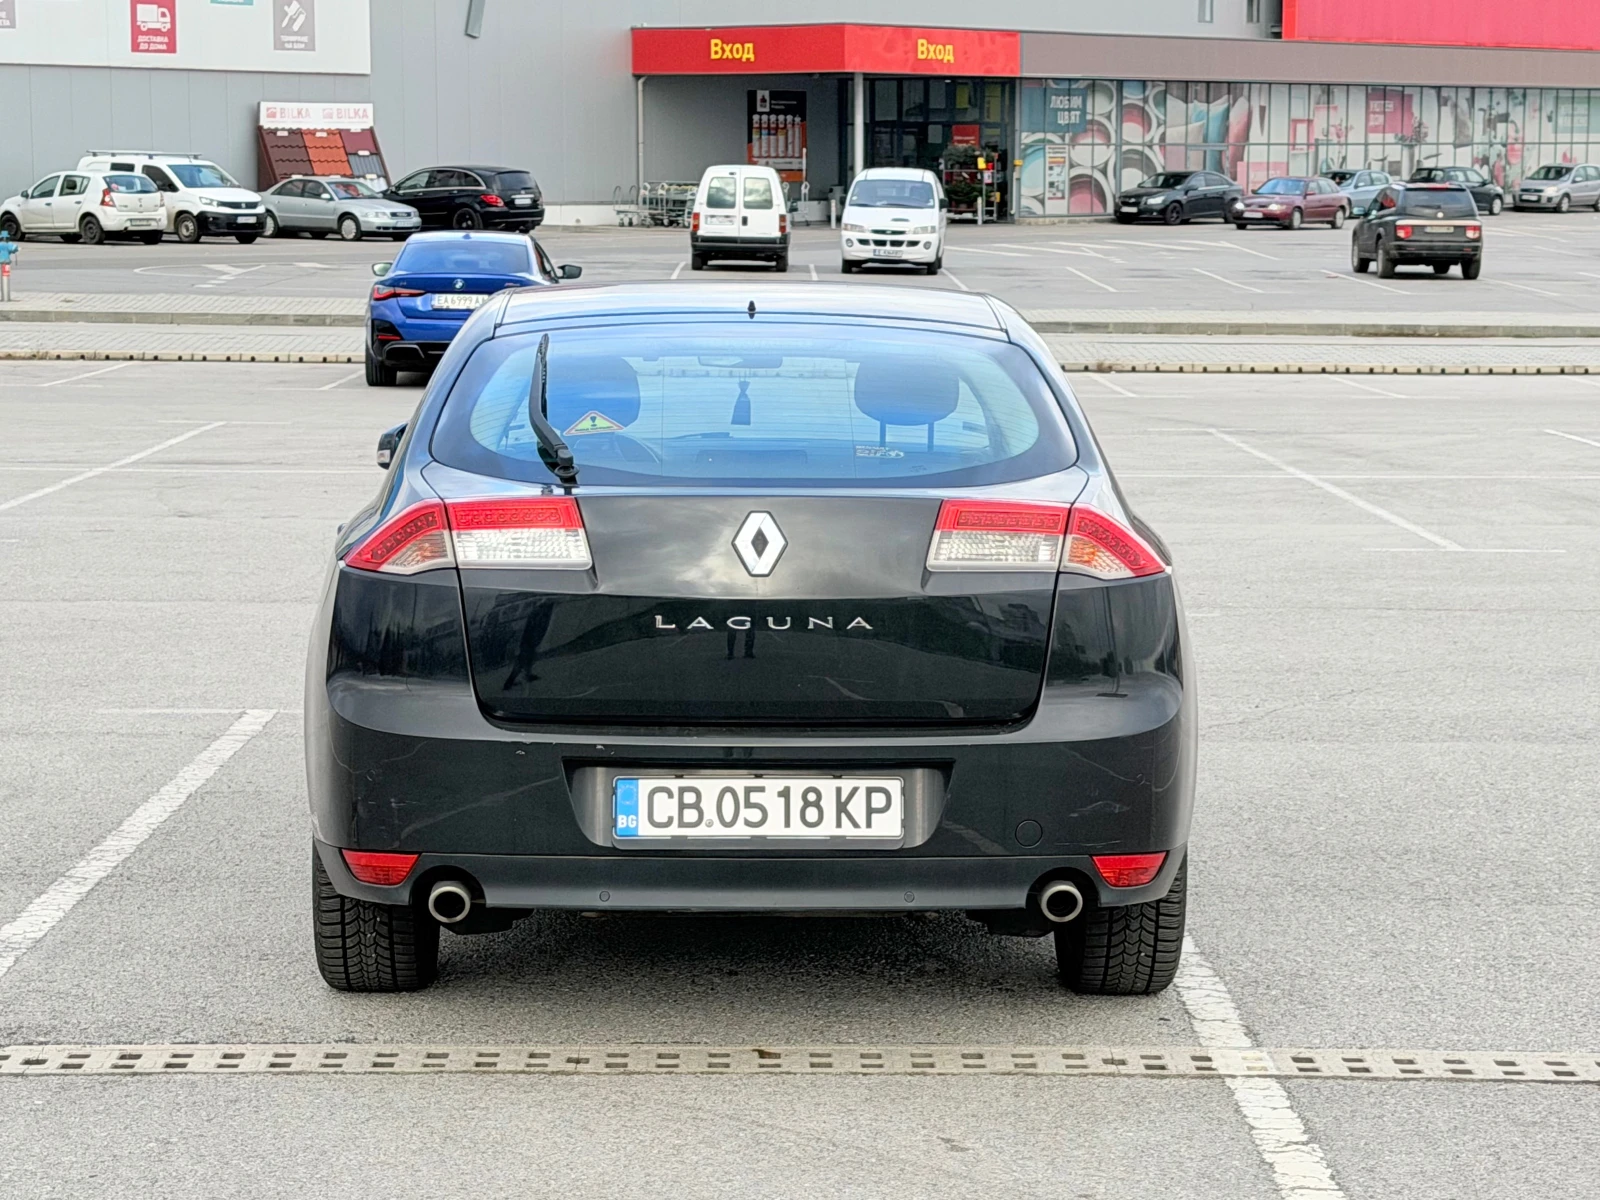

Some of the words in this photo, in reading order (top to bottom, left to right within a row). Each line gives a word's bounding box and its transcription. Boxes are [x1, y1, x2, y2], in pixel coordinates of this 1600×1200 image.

[710, 38, 755, 62] Вход
[917, 38, 955, 64] Вход
[1050, 95, 1083, 109] ЛЮБИМ
[280, 106, 311, 119] BILKA
[336, 106, 369, 119] BILKA
[654, 615, 874, 630] LAGUNA
[617, 815, 637, 829] BG
